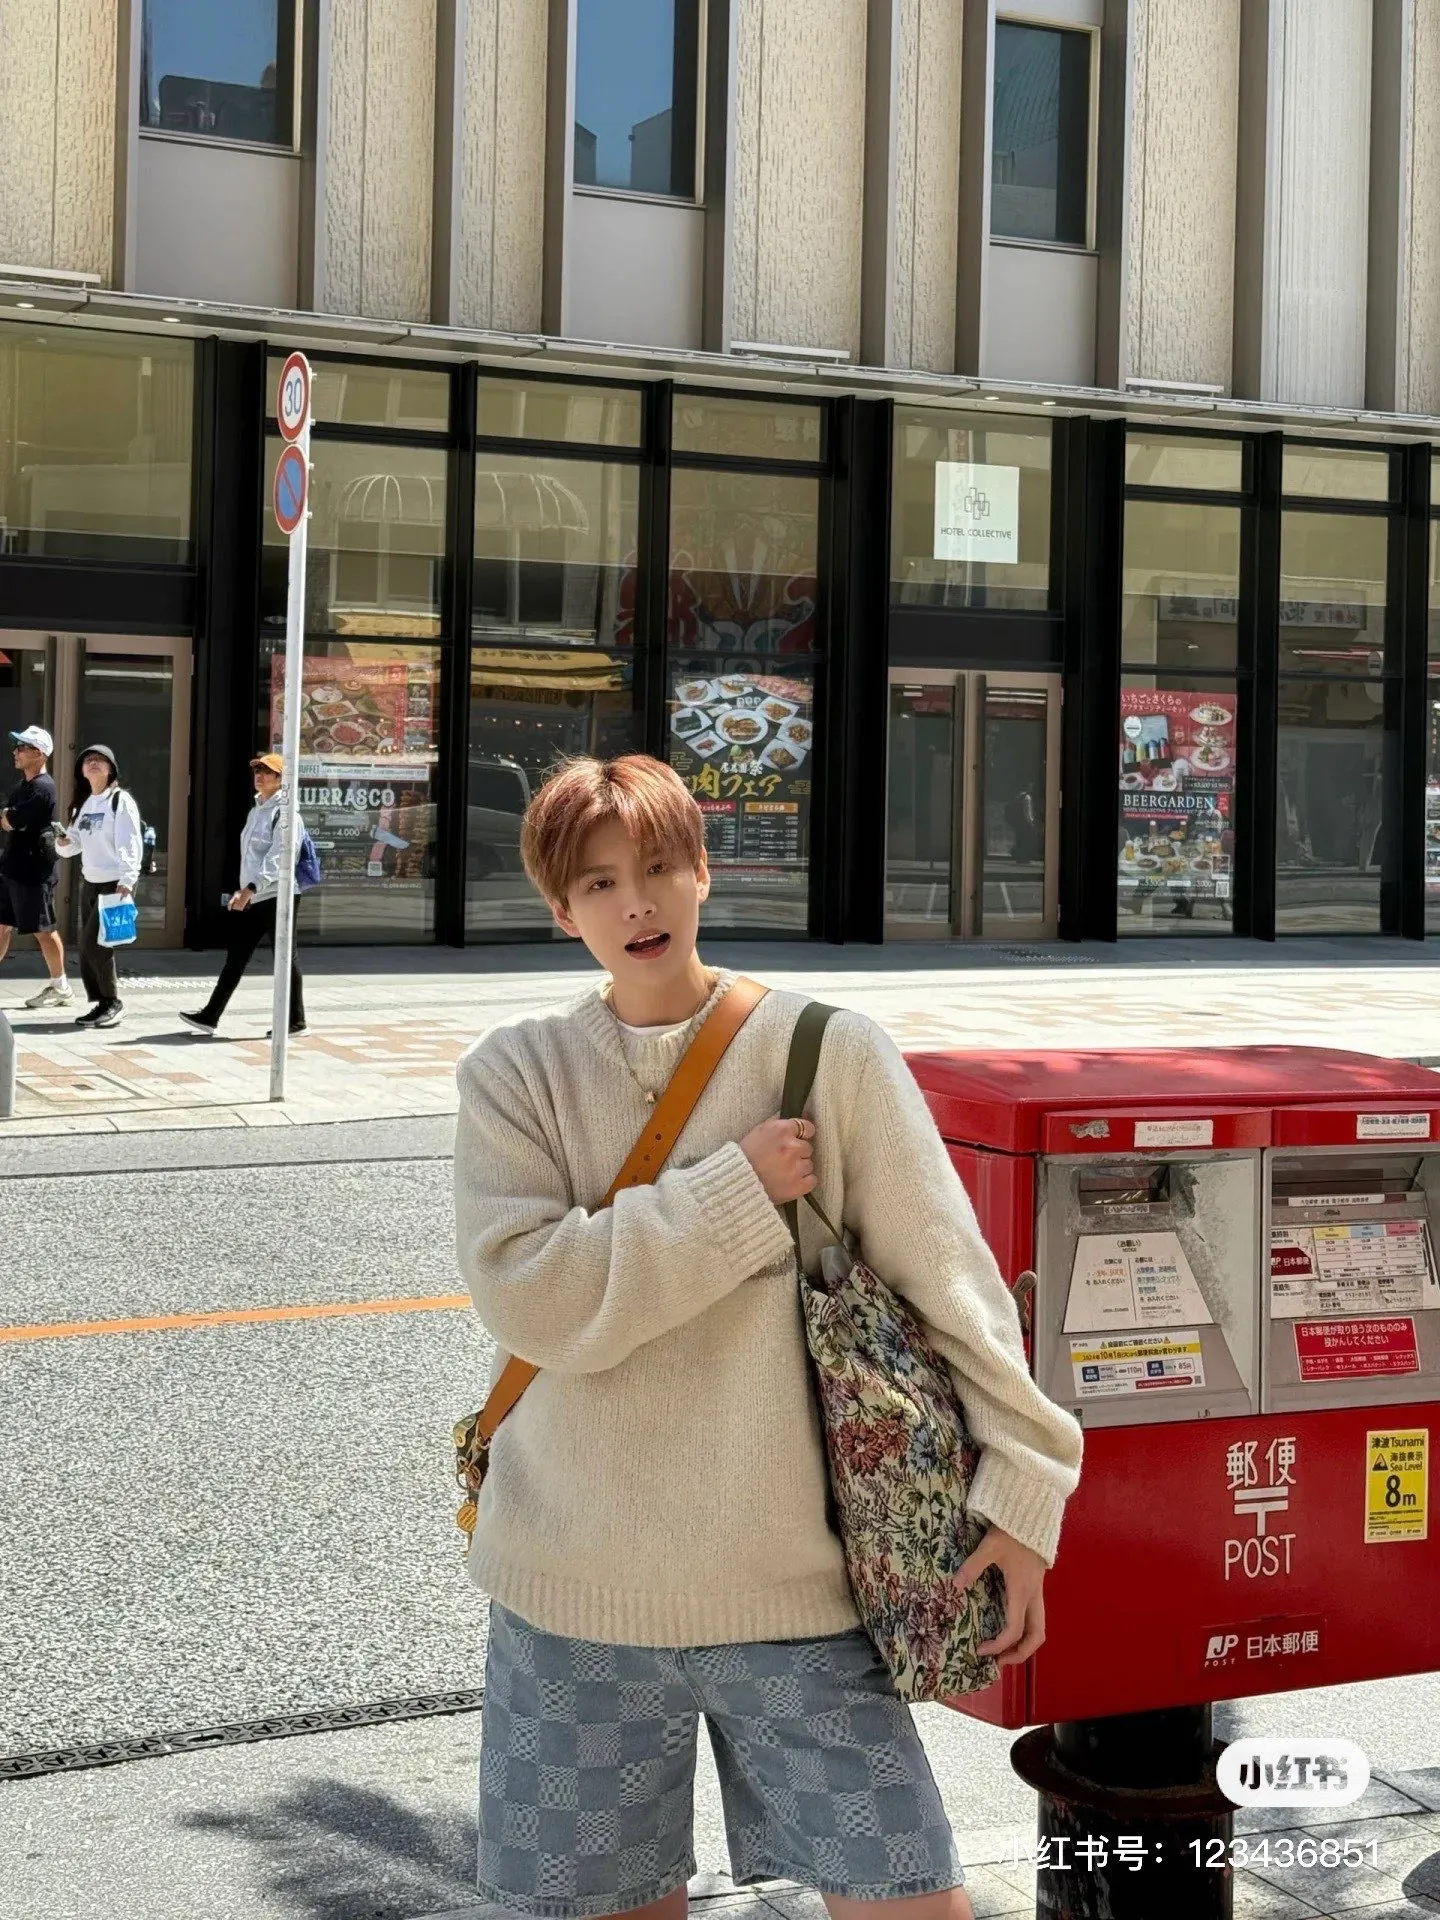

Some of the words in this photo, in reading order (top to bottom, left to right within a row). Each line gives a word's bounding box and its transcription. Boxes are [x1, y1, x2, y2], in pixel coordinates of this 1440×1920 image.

[284, 378, 302, 417] 30
[940, 527, 965, 536] HOTEL
[967, 529, 1012, 539] COLLECTIVE
[1123, 794, 1214, 808] BEERGARDEN
[1390, 1435, 1425, 1447] Tsunami
[1226, 1437, 1297, 1490] 郵便
[1390, 1462, 1402, 1472] Sea
[1404, 1462, 1422, 1471] Level
[1224, 1533, 1297, 1581] POST
[1246, 1630, 1319, 1659] 日本郵便
[1204, 1658, 1237, 1668] POST
